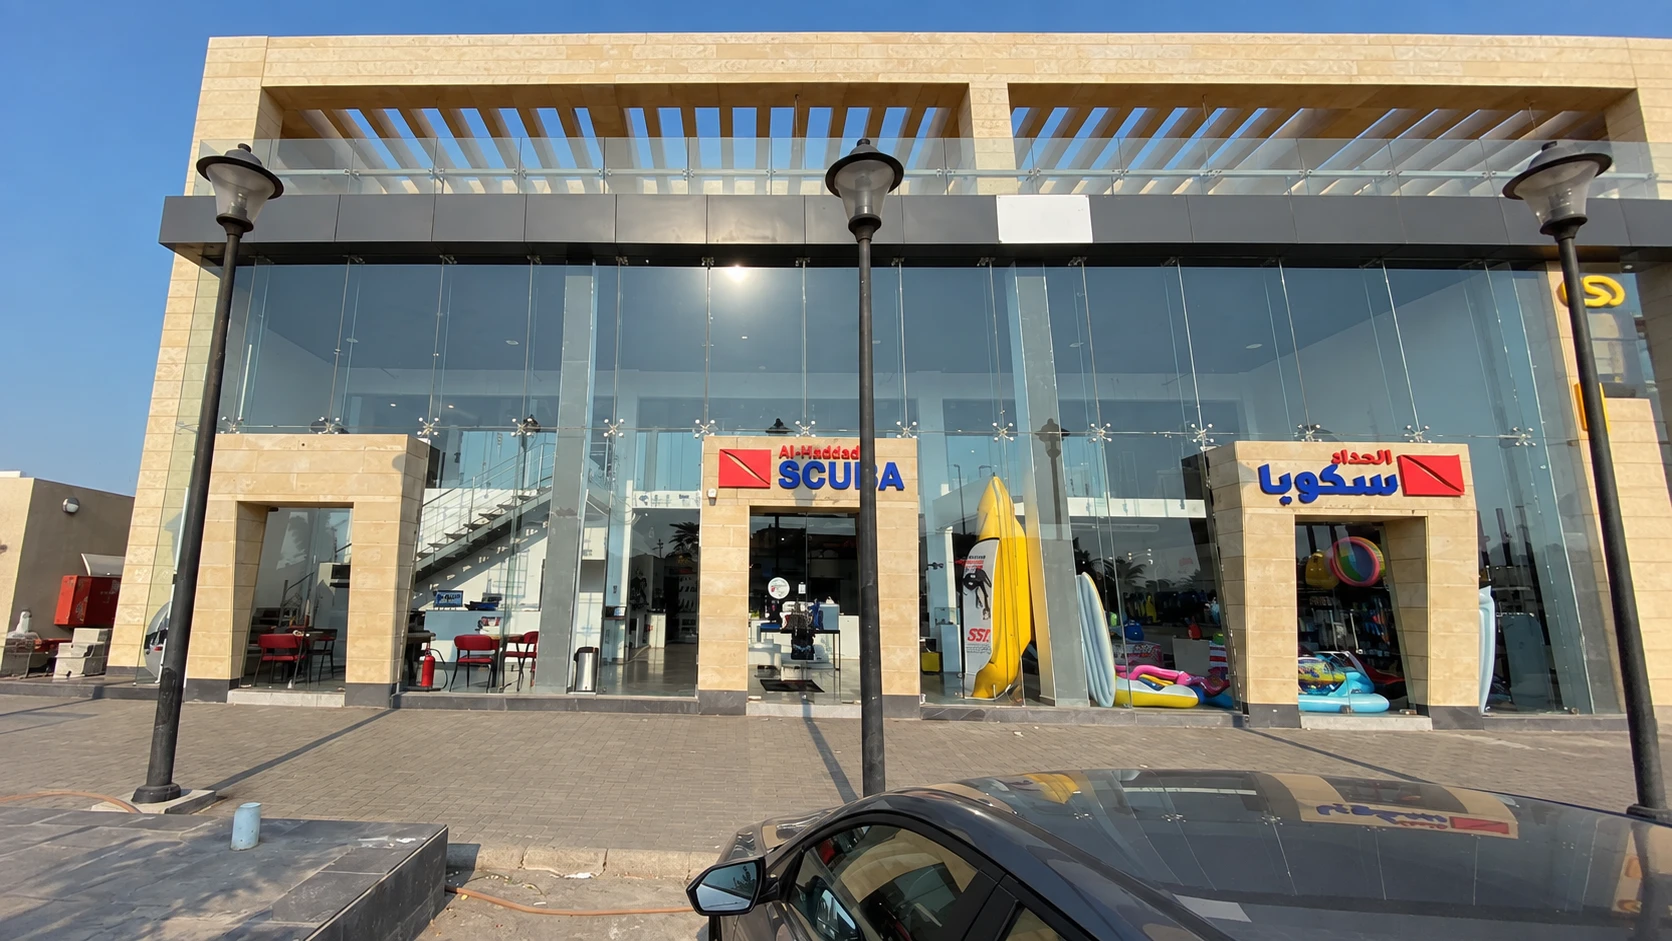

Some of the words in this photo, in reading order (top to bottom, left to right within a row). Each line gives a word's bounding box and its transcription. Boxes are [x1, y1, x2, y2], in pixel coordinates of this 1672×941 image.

[779, 445, 860, 460] Al-Haddad
[1331, 449, 1392, 465] الحداد
[1258, 463, 1398, 506] سكوبا
